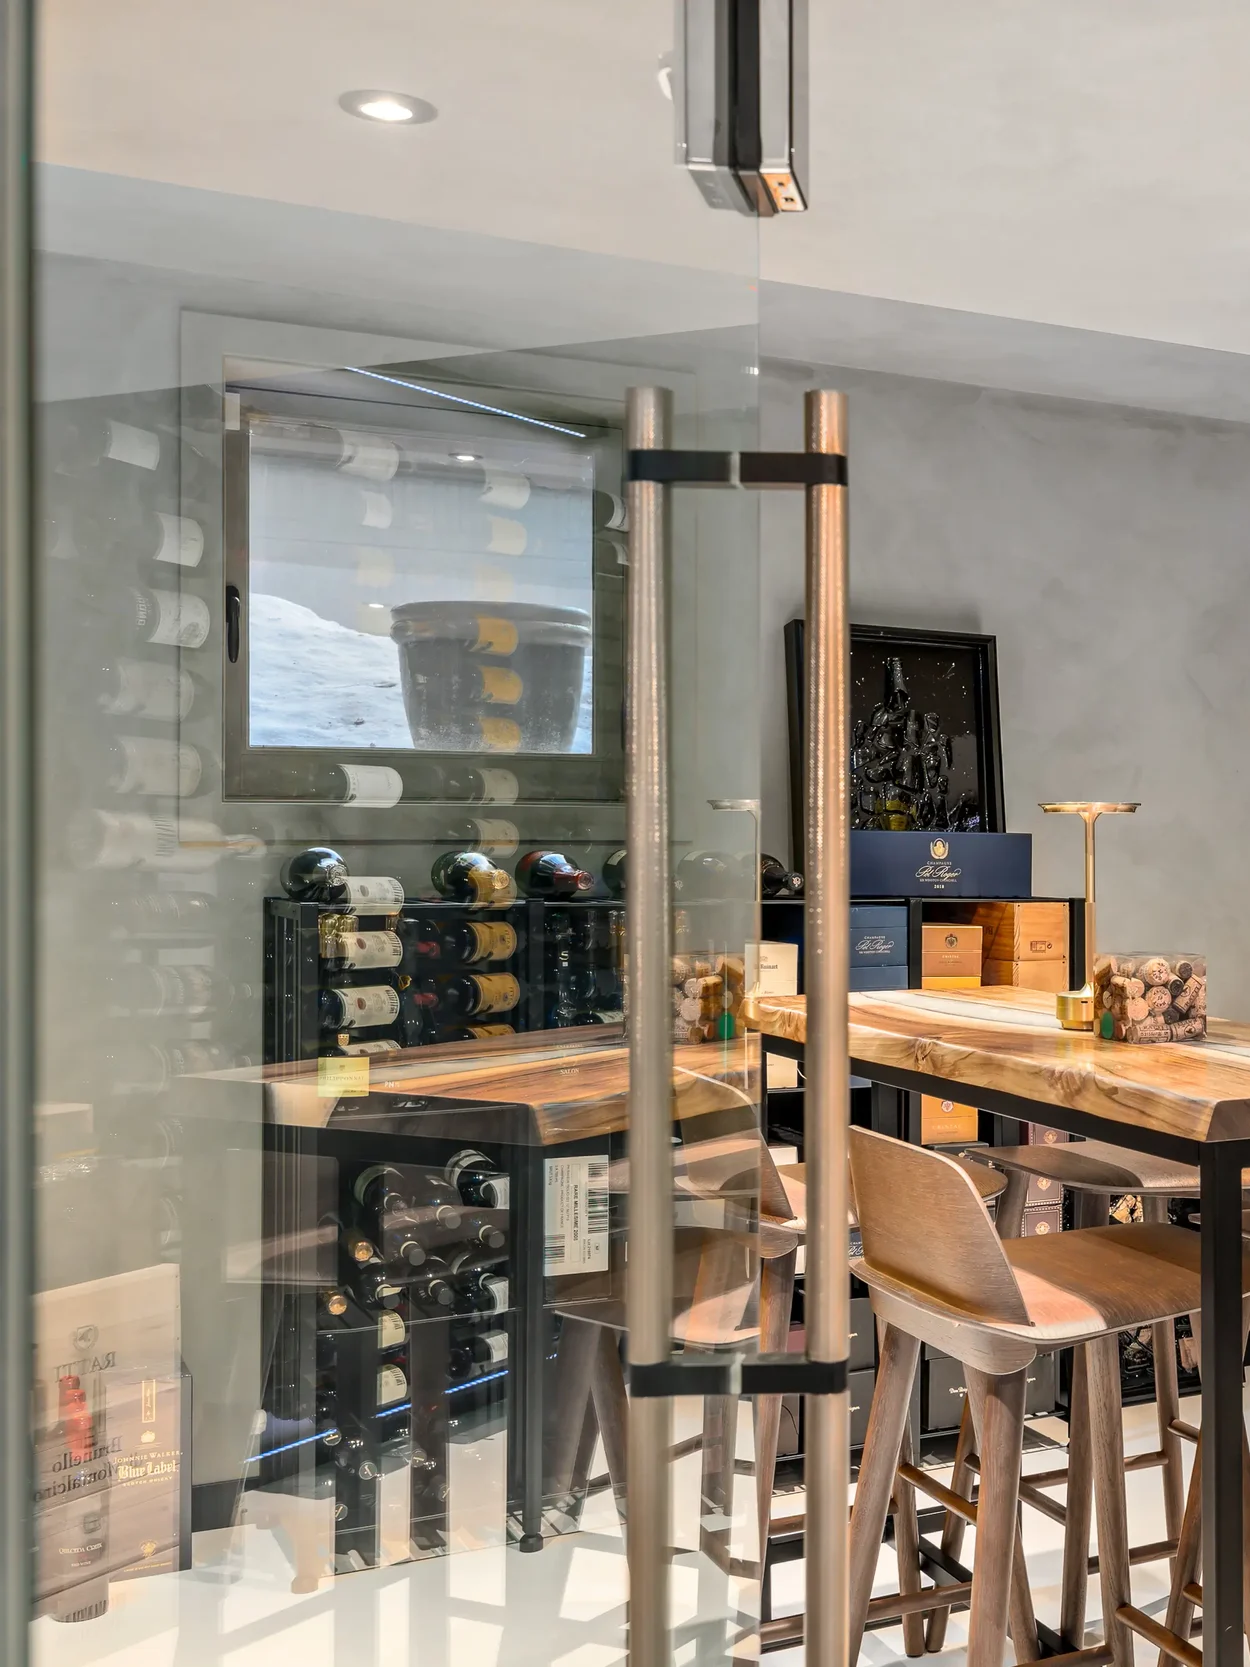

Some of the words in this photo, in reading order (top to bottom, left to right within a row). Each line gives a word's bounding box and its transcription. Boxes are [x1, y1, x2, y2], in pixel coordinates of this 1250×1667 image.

[932, 866, 962, 881] Roger
[869, 939, 895, 952] Roger
[113, 1454, 148, 1464] JOHNNIE
[117, 1464, 146, 1481] Blue
[146, 1460, 176, 1475] Label
